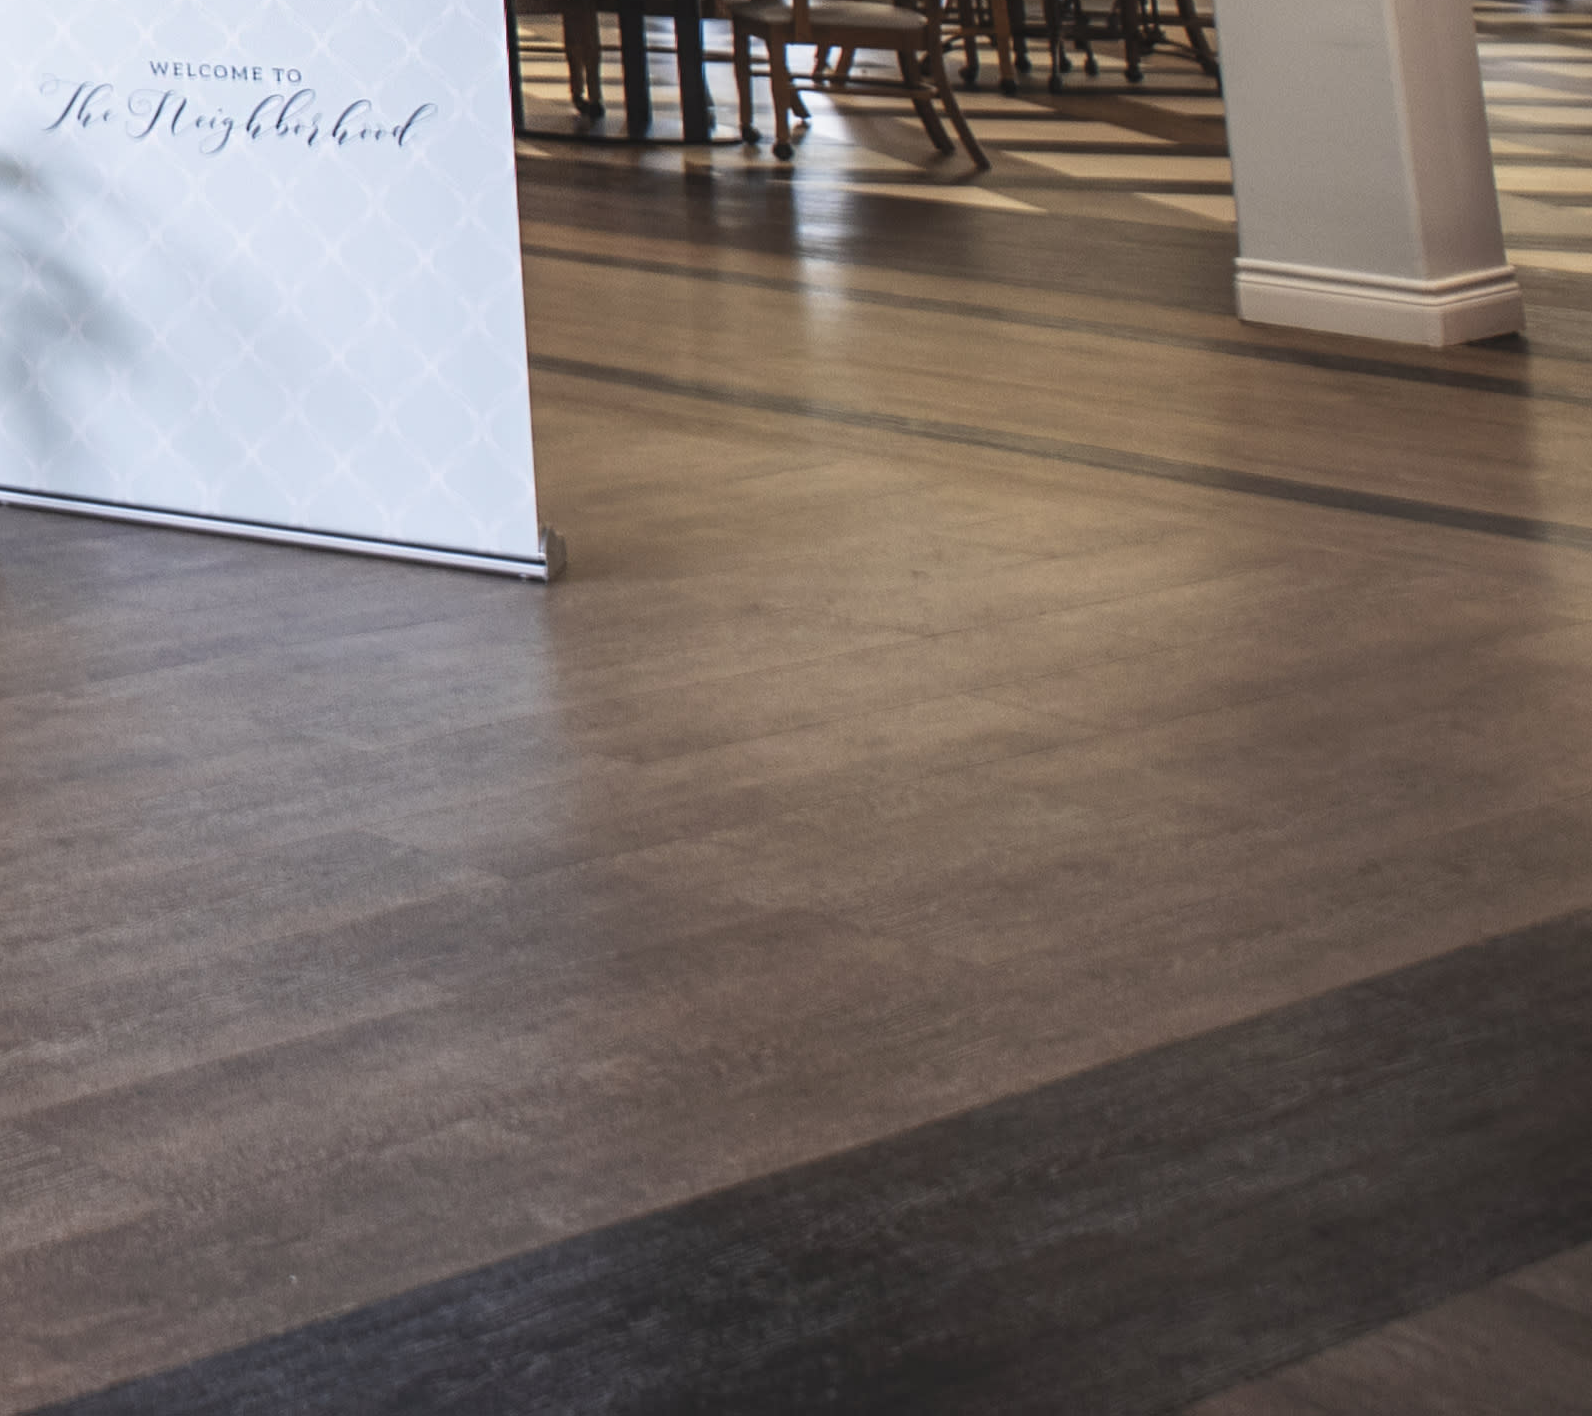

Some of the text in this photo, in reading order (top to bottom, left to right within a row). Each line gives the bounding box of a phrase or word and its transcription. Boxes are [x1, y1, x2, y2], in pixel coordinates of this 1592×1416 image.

[149, 60, 303, 84] WELCOME TO
[39, 73, 438, 156] The Neighborhood
